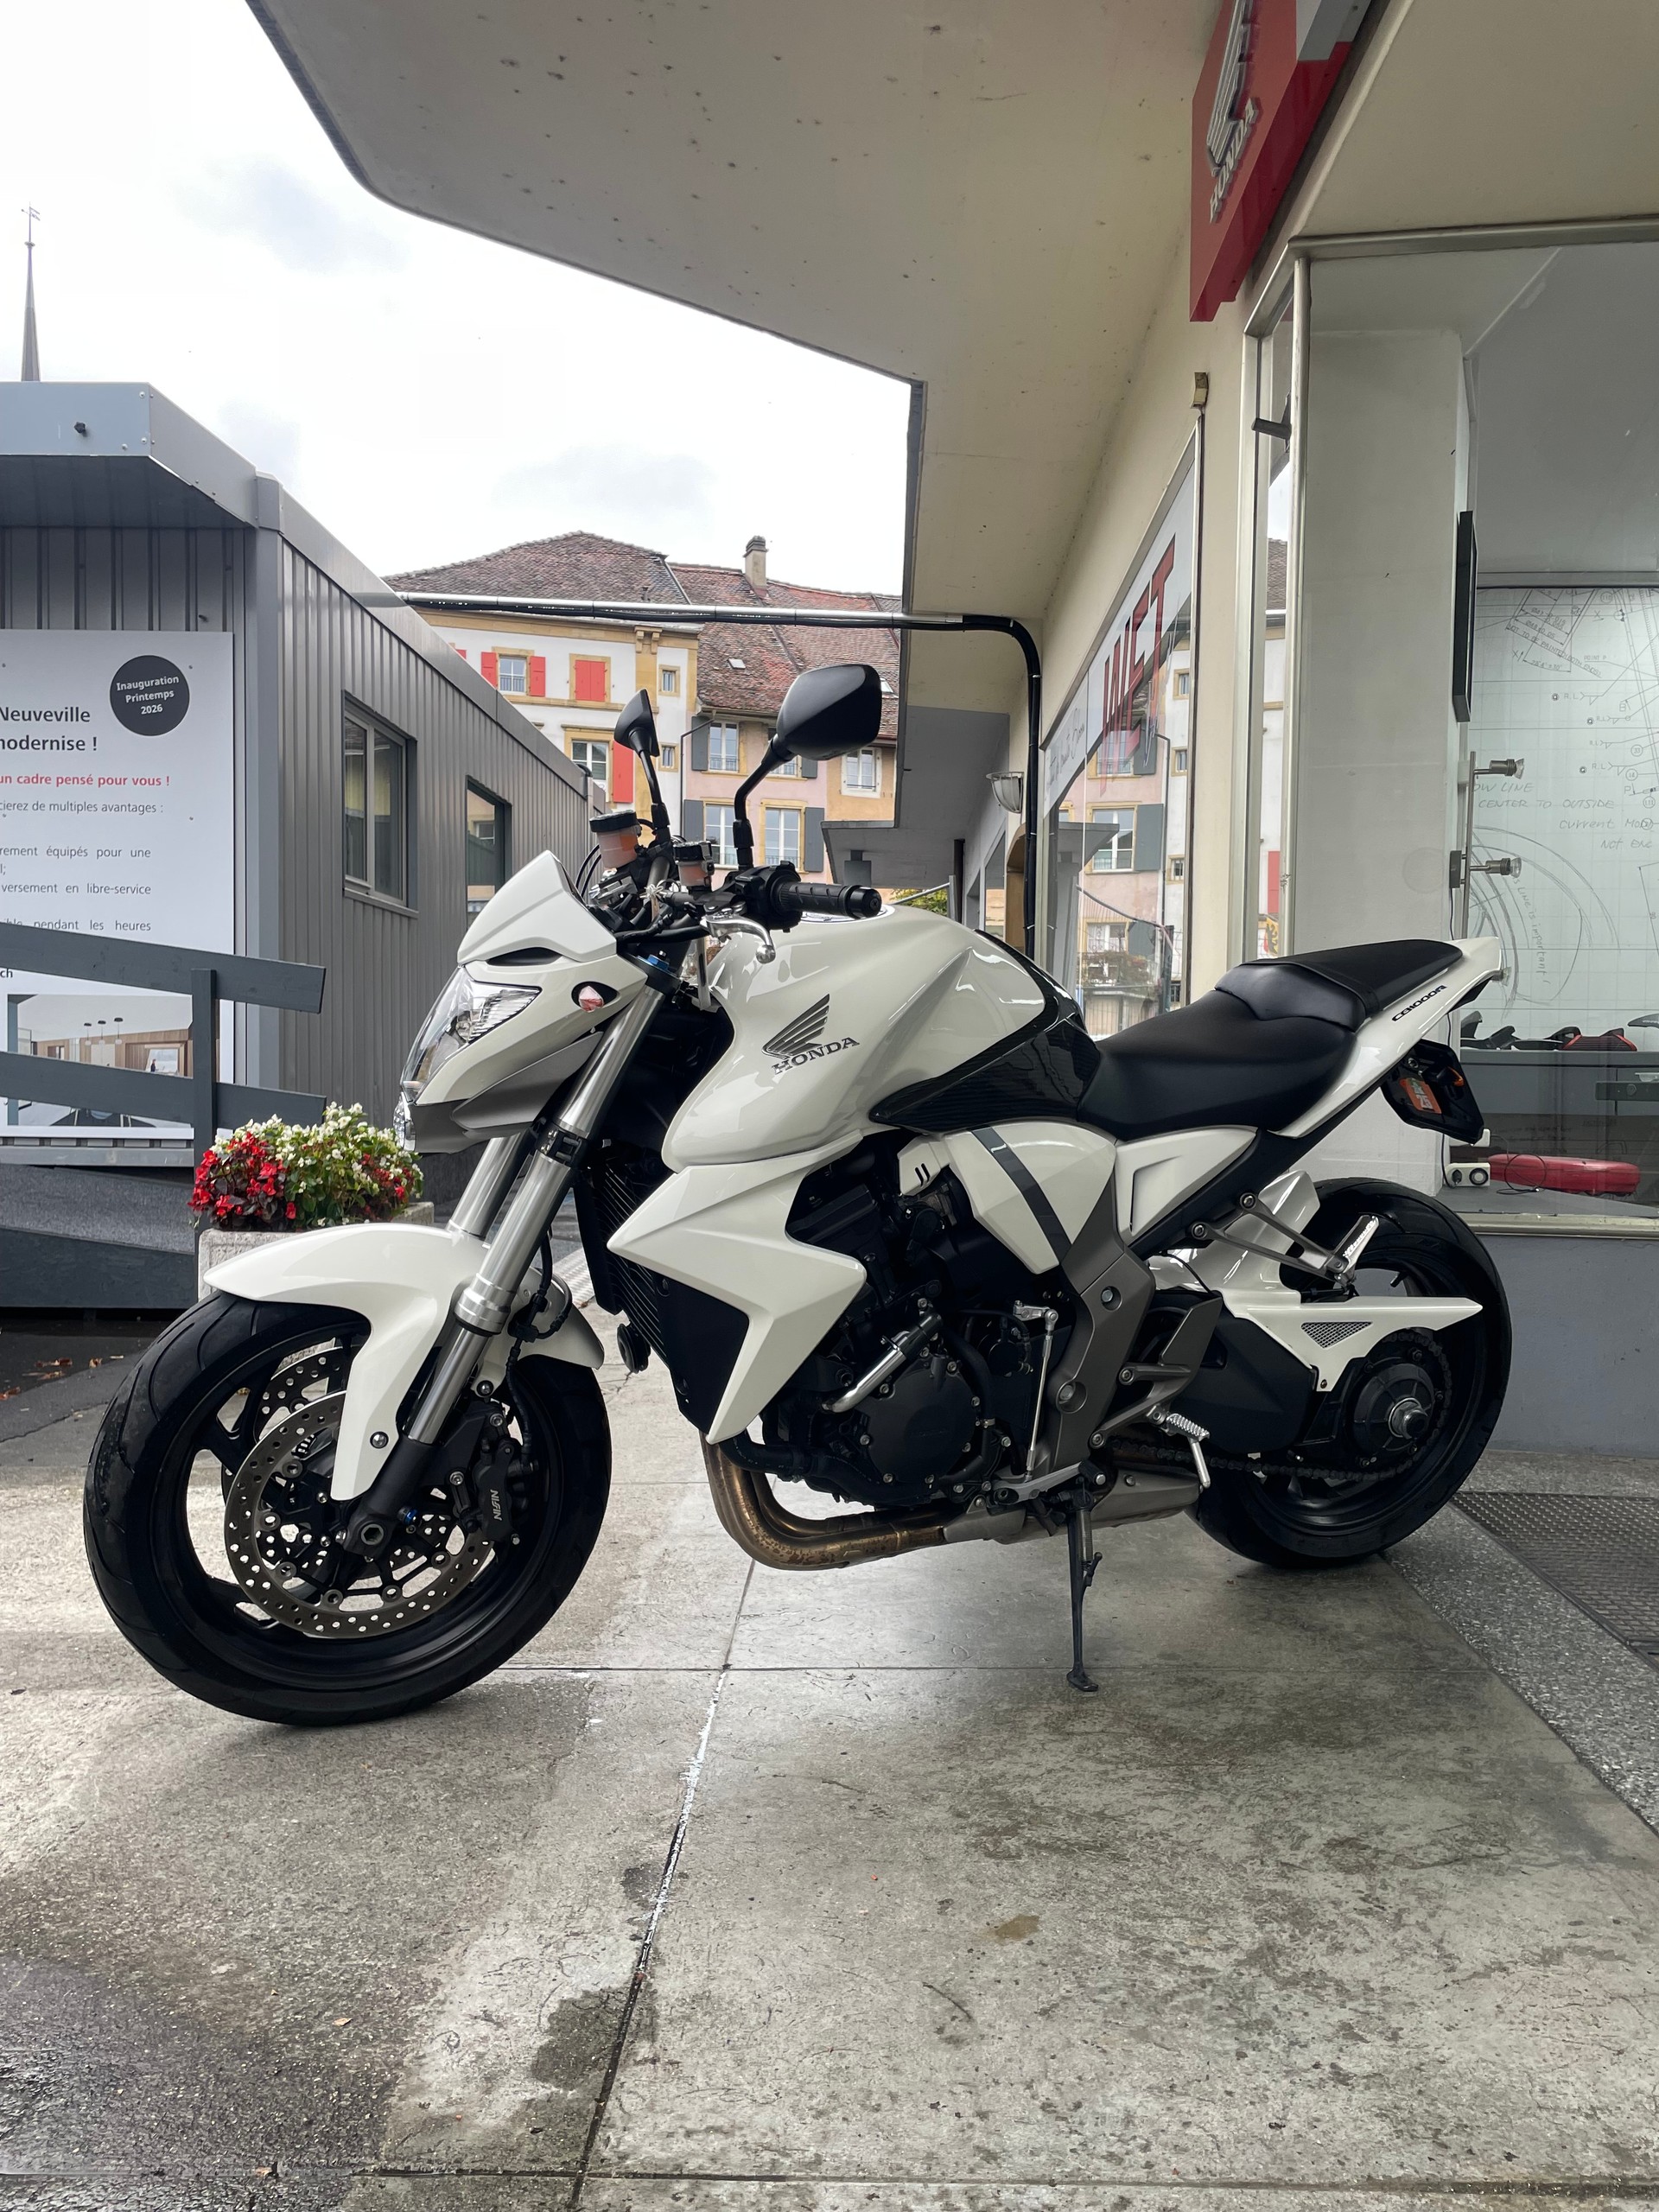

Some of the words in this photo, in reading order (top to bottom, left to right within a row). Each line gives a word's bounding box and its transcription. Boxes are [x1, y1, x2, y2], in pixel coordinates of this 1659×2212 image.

[116, 676, 180, 691] Inauguration
[125, 690, 175, 703] Printemps
[0, 706, 91, 723] Neuveville
[140, 703, 163, 715] 2026
[16, 772, 52, 785] cadre
[55, 773, 94, 788] pensé
[98, 777, 128, 788] pour
[131, 777, 162, 786] vous
[1501, 782, 1535, 793] LINE
[32, 800, 46, 812] de
[48, 800, 99, 814] multiples
[101, 803, 157, 816] avantages
[1478, 798, 1529, 809] CENTER
[1536, 799, 1553, 809] TO
[1562, 798, 1615, 809] OUTSIDE
[46, 845, 88, 860] équipés
[96, 848, 123, 860] pour
[1, 883, 58, 894] versement
[65, 885, 79, 893] en
[86, 883, 152, 895] libre-service
[90, 919, 105, 931] les
[115, 920, 152, 931] heures
[1391, 984, 1447, 1022] CB1000R
[771, 1036, 861, 1075] HONDA
